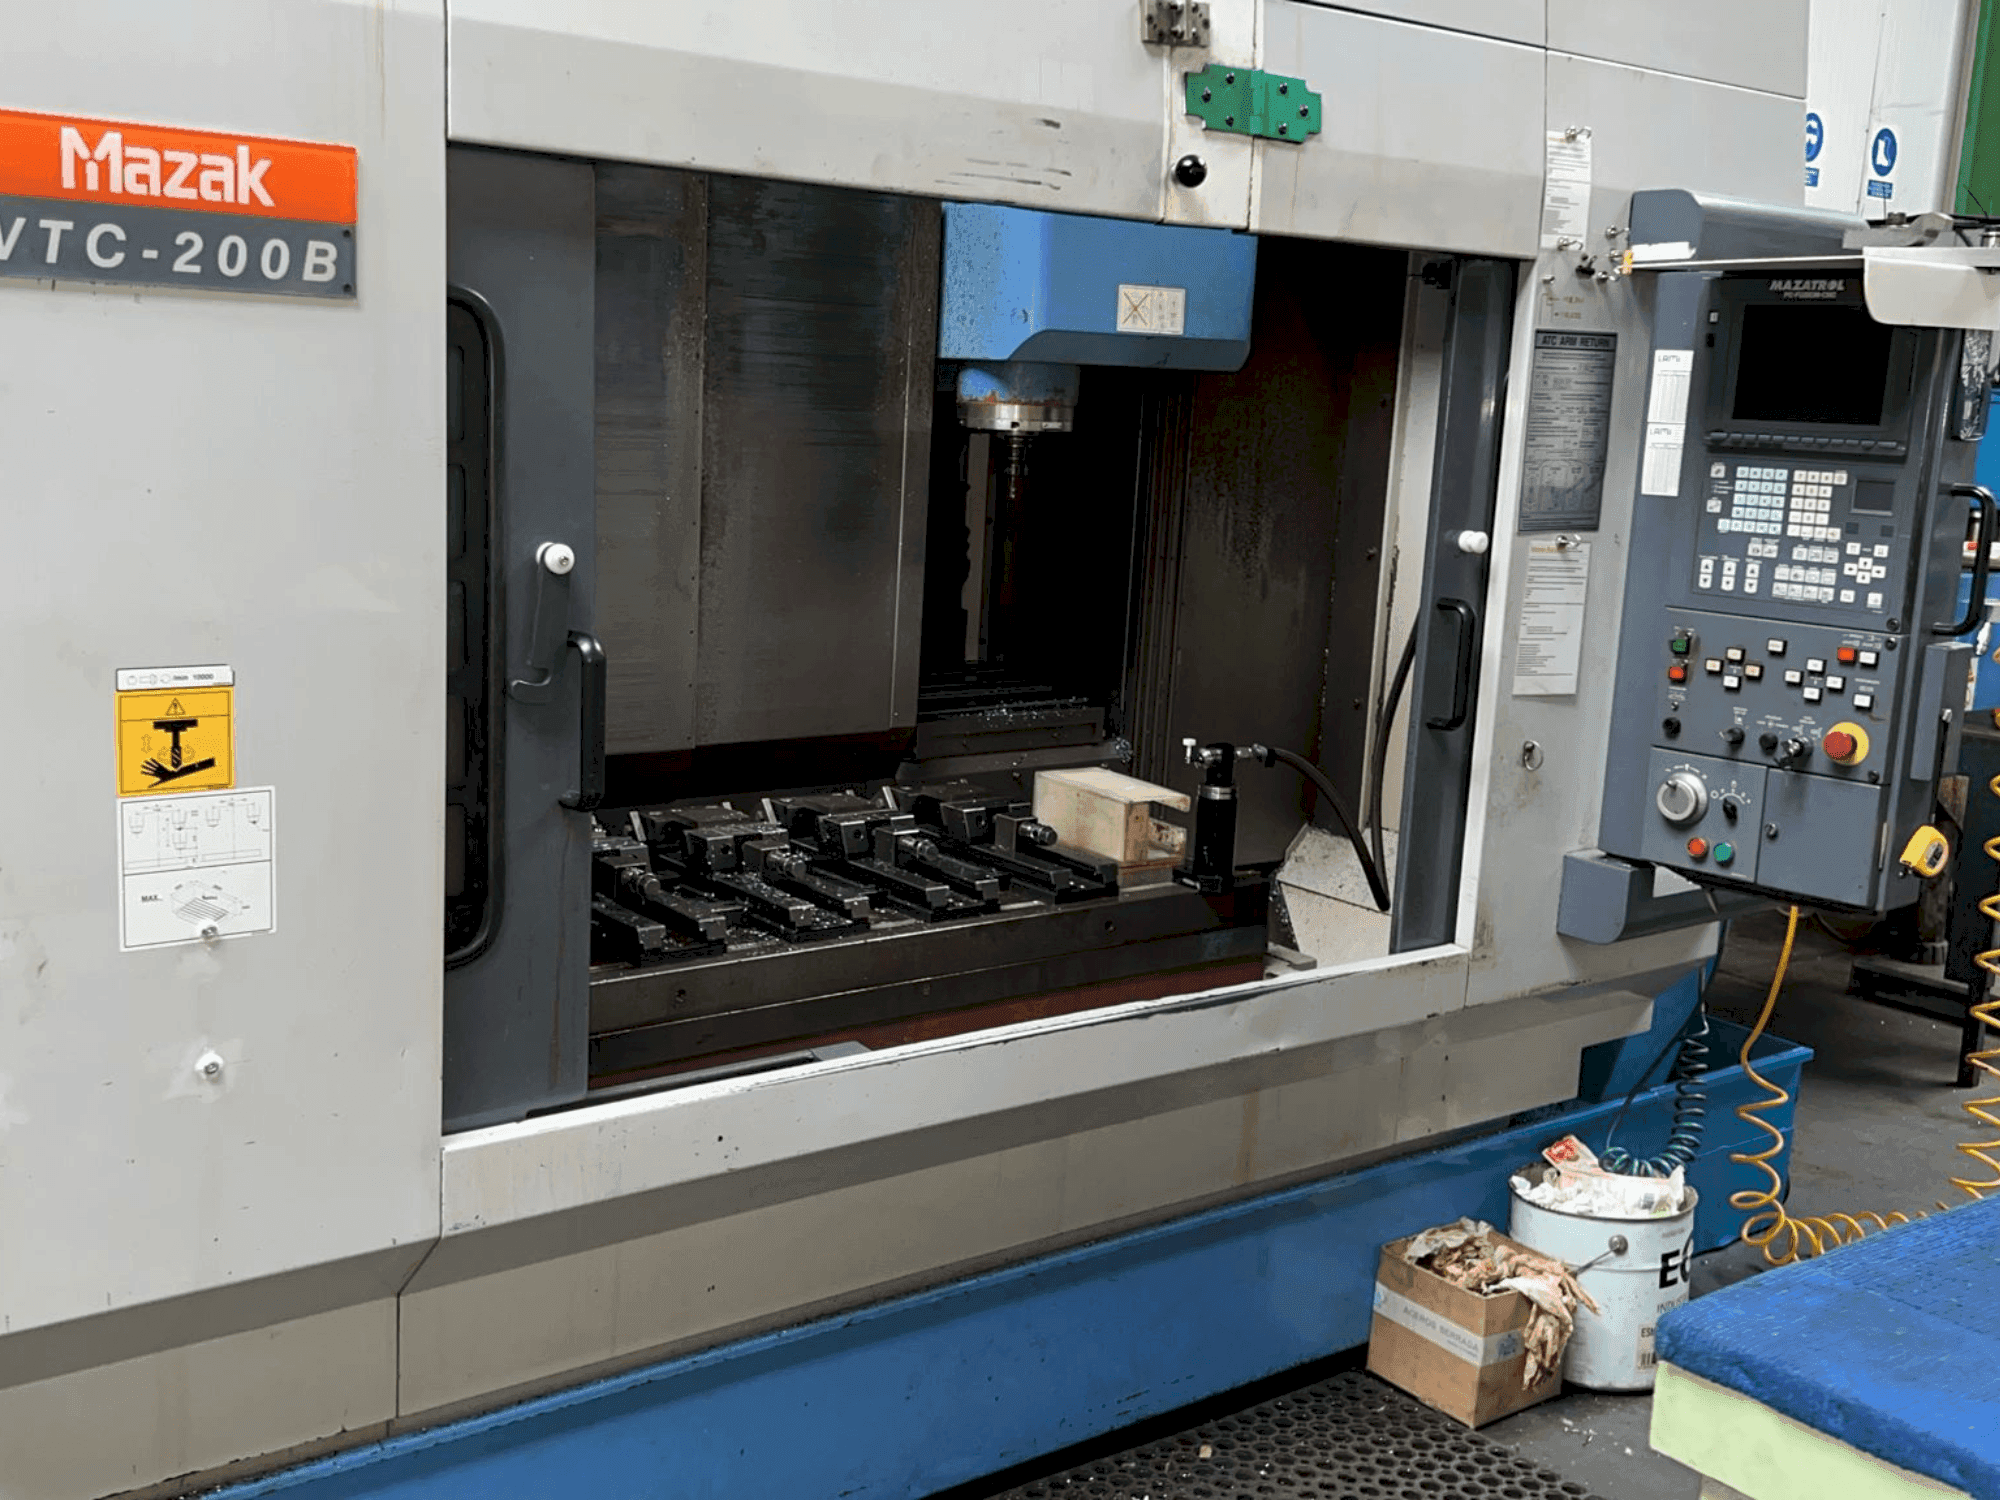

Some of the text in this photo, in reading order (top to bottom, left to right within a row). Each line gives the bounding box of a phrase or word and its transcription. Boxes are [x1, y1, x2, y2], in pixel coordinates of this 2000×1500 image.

[59, 125, 275, 207] Mazak
[0, 217, 339, 283] VTC-200B
[1769, 279, 1845, 291] MAZATROL
[1541, 335, 1557, 346] ATC
[1579, 336, 1610, 348] RETURN
